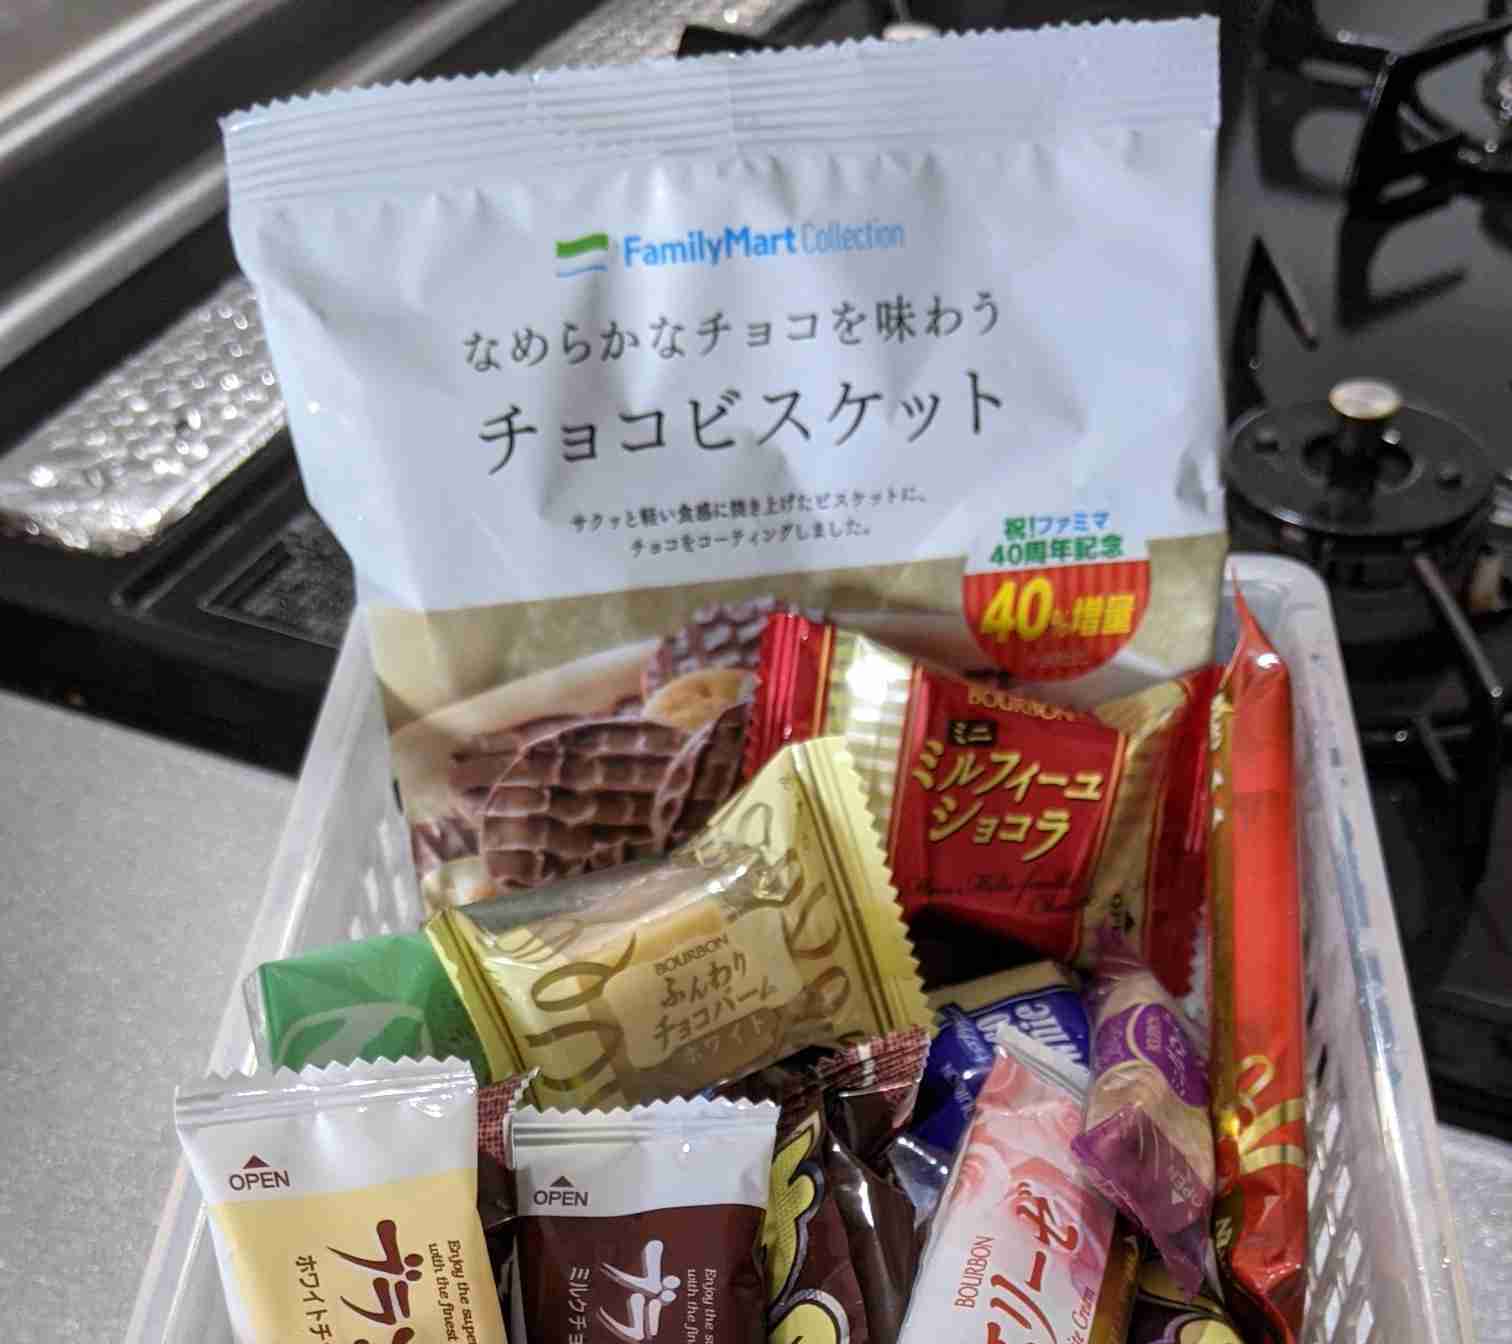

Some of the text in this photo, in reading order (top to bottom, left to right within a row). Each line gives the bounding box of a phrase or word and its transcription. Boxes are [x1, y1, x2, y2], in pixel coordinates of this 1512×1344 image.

[622, 219, 904, 269] FamilyMart Collection
[462, 289, 1002, 374] なめらかなチョコを味わう
[478, 368, 1002, 475] チョコビスケット
[631, 519, 871, 558] チョコをコーティングしました。
[991, 533, 1123, 565] 40周年記念
[954, 721, 993, 744] ミニ
[912, 739, 1103, 803] ミルフィーユ
[929, 796, 1070, 862] ショコラ
[654, 933, 729, 976] BOURBON
[661, 952, 747, 1007] ふんわり
[229, 1170, 290, 1191] OPEN
[534, 1190, 588, 1206] OPEN
[428, 1243, 446, 1272] with
[448, 1240, 464, 1278] Enjoy
[458, 1281, 470, 1304] the
[954, 1235, 995, 1308] BOURBON
[437, 1277, 449, 1300] the
[687, 1268, 699, 1297] with
[702, 1268, 717, 1303] Enjoy
[438, 1302, 459, 1344] finest
[687, 1300, 699, 1322] the
[705, 1307, 717, 1331] the
[1071, 1287, 1095, 1331] Cream
